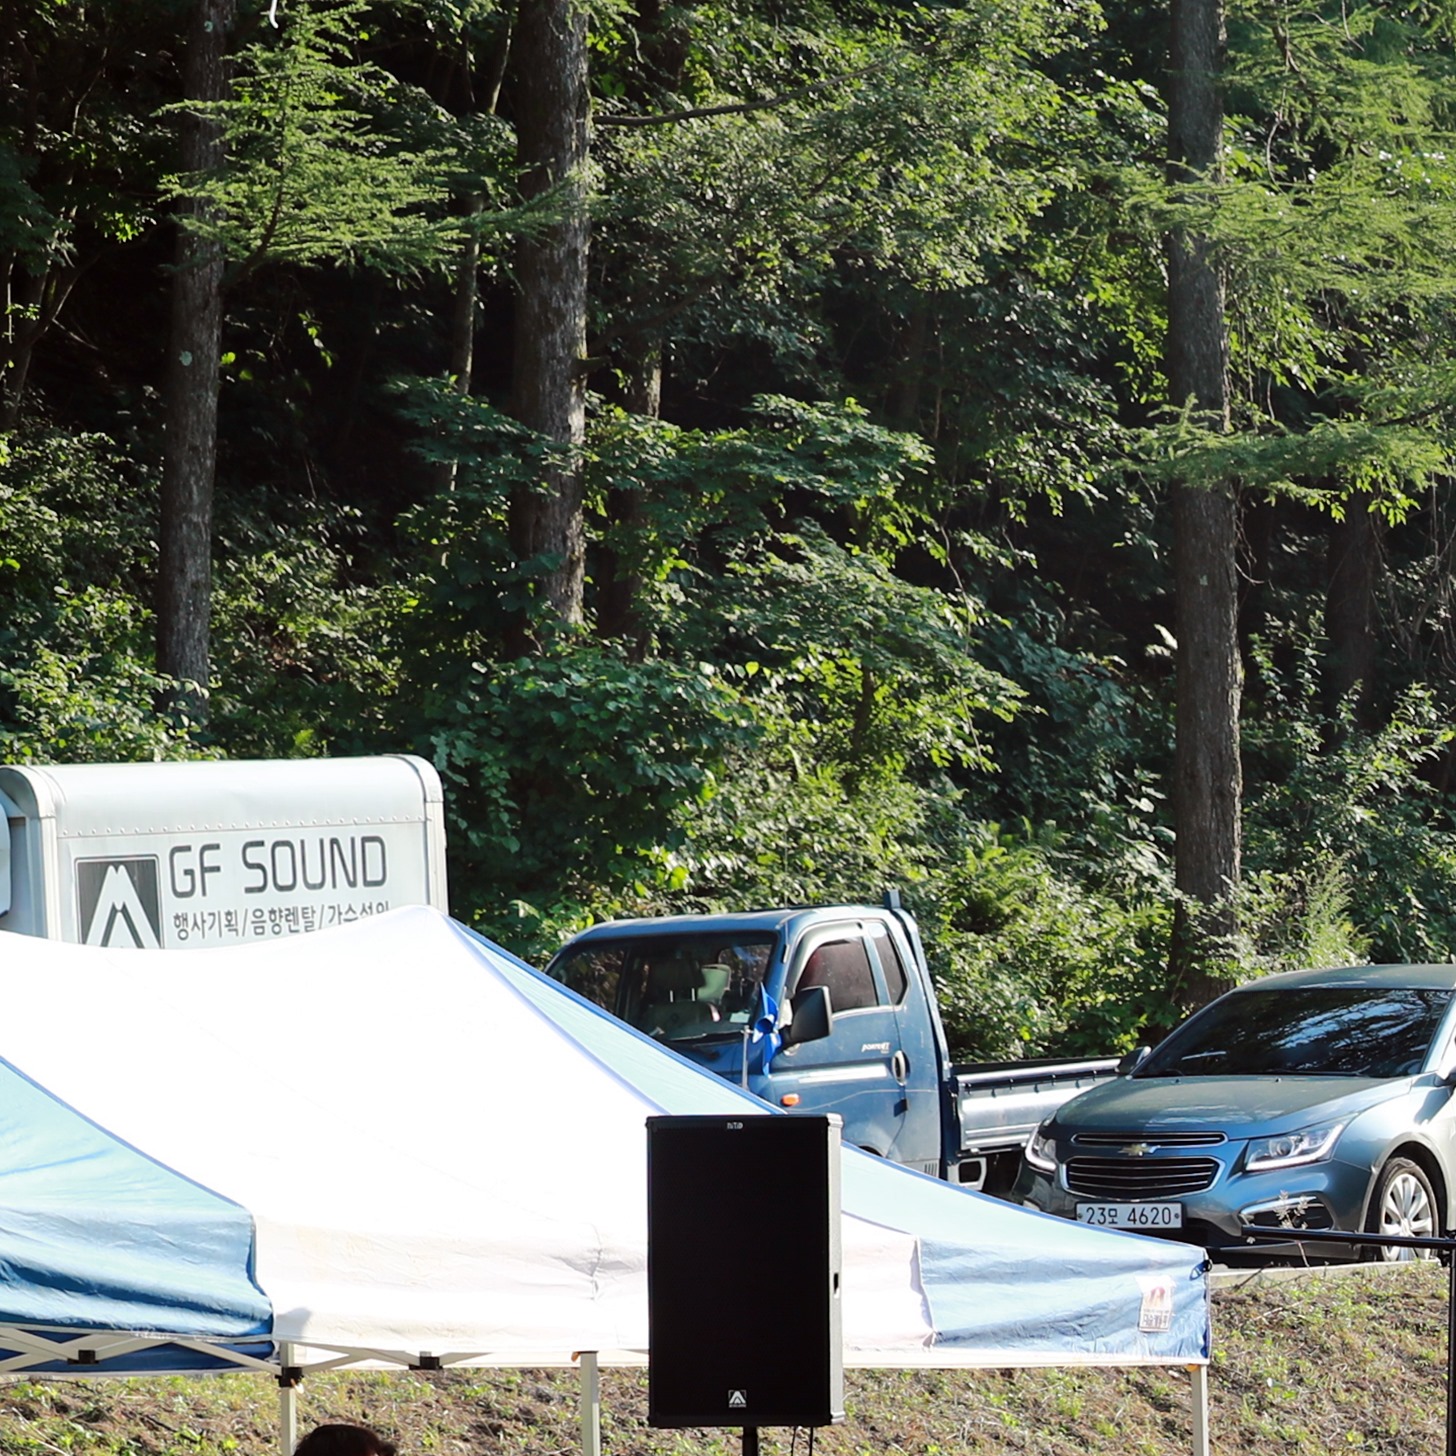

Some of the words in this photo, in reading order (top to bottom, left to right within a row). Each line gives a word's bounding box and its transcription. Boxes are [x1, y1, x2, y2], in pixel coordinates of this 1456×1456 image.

[168, 844, 222, 899] GF
[241, 835, 388, 894] SOUND
[1086, 1206, 1118, 1225] 23모
[1127, 1205, 1172, 1226] 4620
